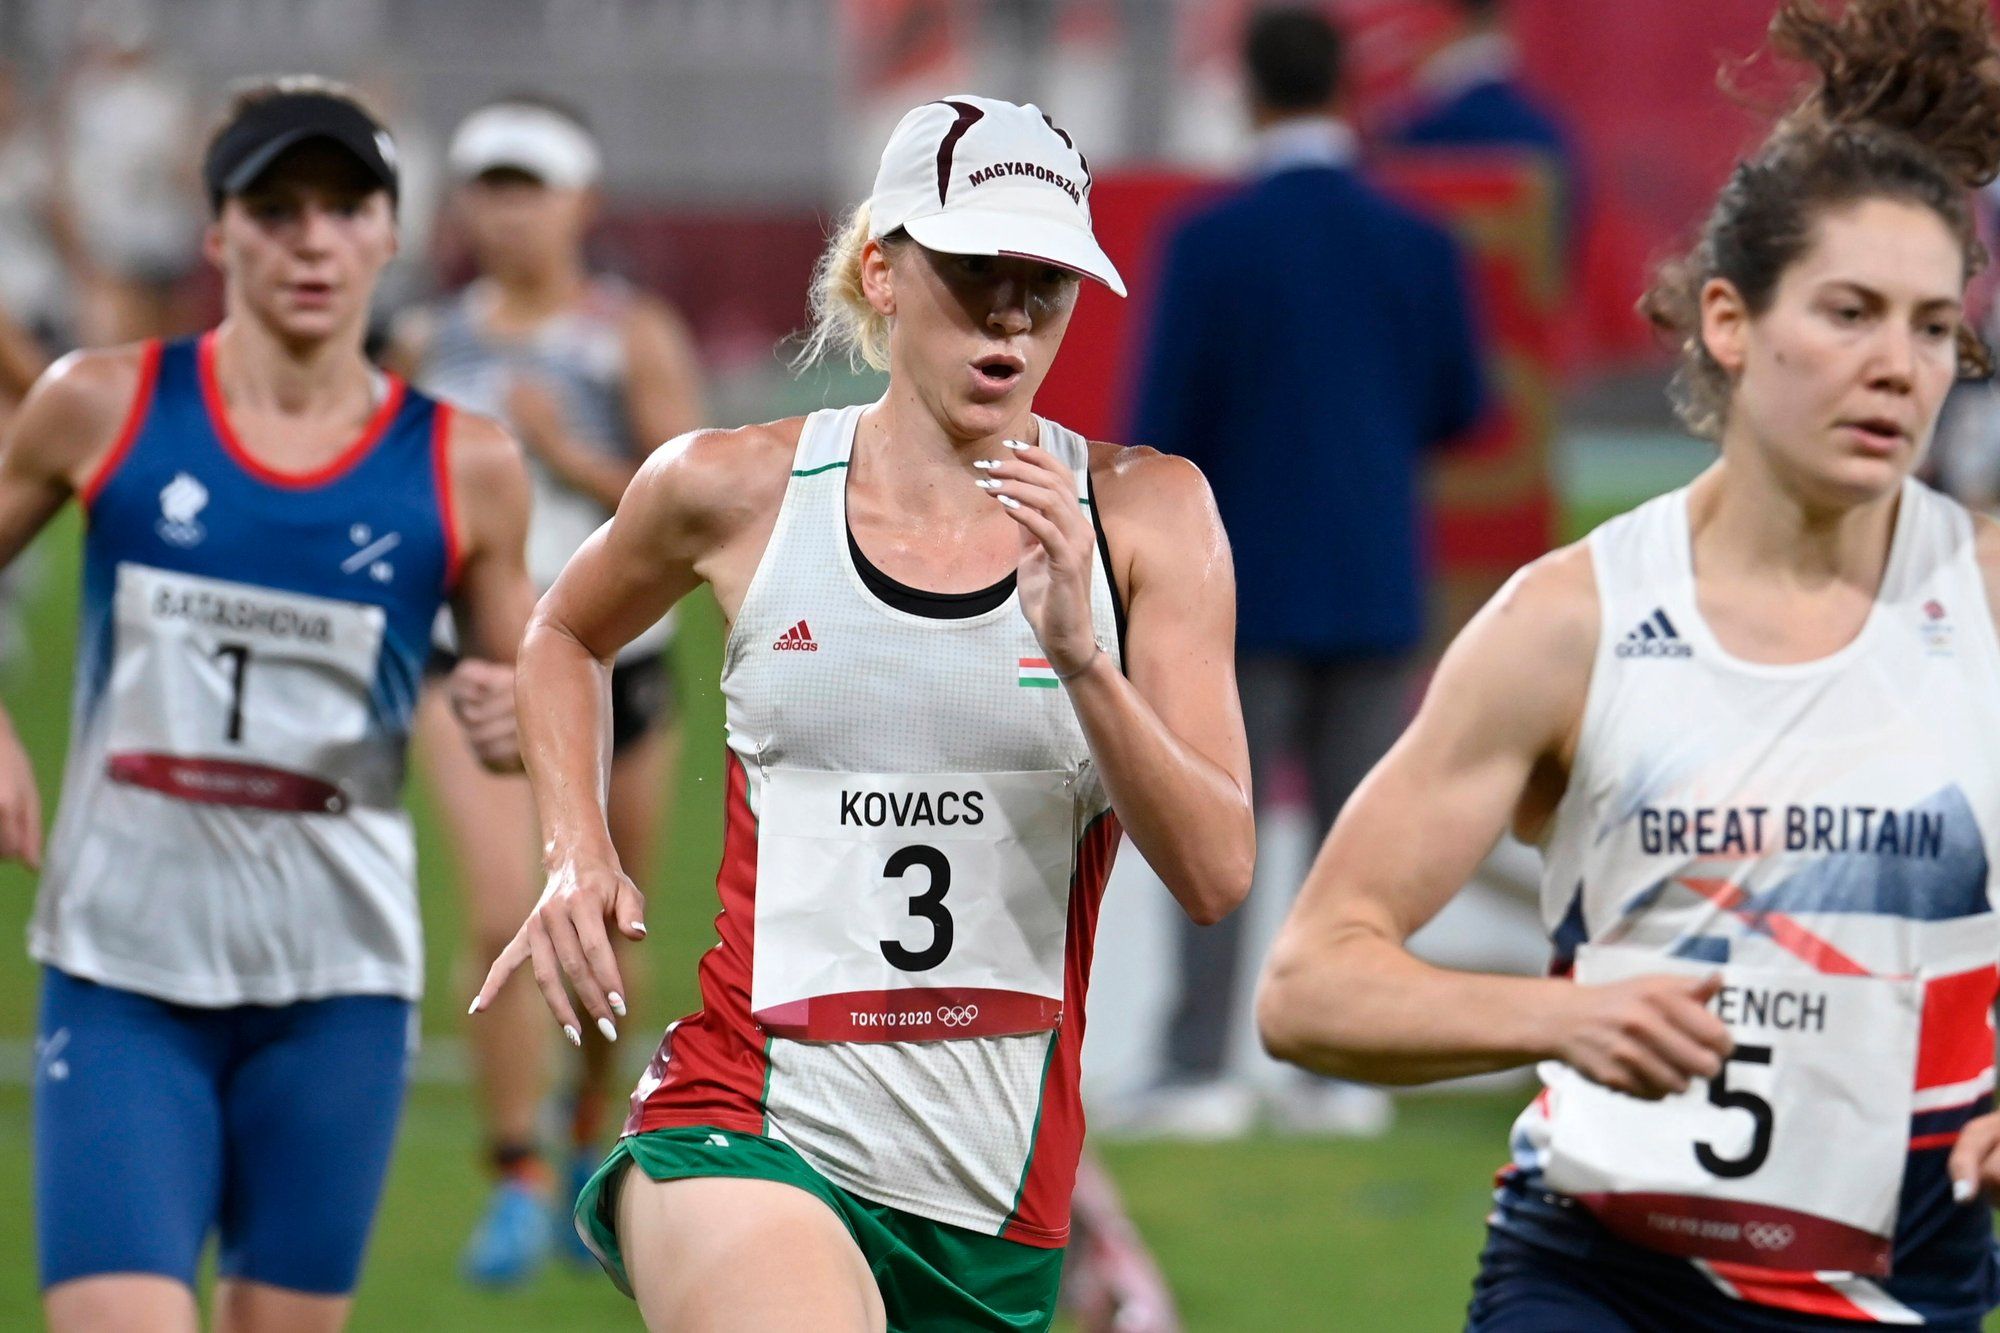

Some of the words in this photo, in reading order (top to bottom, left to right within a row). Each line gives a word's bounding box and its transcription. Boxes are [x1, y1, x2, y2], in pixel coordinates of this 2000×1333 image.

[773, 638, 818, 652] adidas
[1615, 640, 1694, 659] adidas
[213, 643, 249, 742] 1
[840, 790, 985, 827] KOVACS
[1639, 806, 1770, 857] GREAT
[1784, 806, 1946, 860] BRITAIN
[879, 844, 954, 972] 3
[850, 1011, 896, 1026] TOKYO
[899, 1011, 932, 1026] 2020
[1717, 985, 1827, 1034] ENCH
[1693, 1044, 1774, 1179] 5
